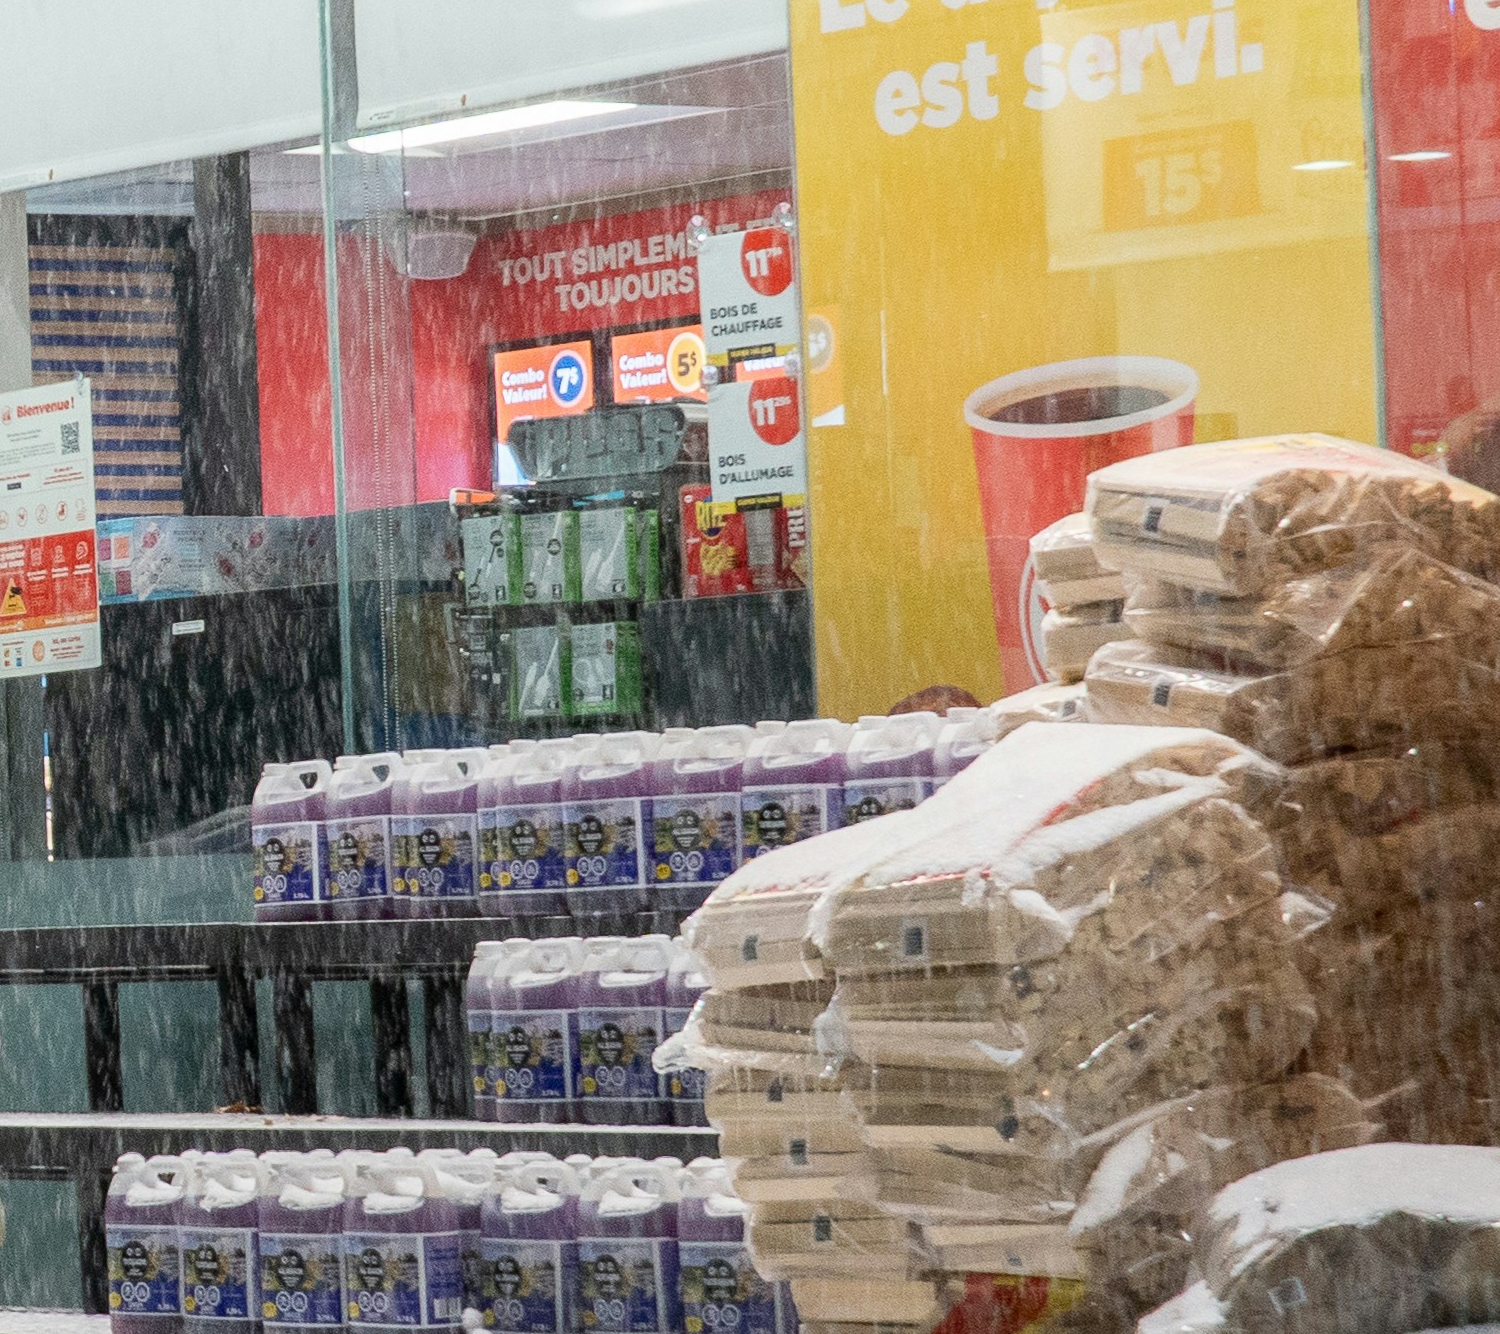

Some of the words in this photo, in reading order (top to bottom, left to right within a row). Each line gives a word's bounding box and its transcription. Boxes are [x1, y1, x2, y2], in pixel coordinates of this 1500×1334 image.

[875, 39, 999, 136] est
[500, 251, 566, 287] TOUT
[555, 267, 696, 312] TOUJOURS
[710, 305, 738, 320] BOIS
[741, 303, 758, 315] DE
[711, 317, 783, 337] CHAUFFAGE
[618, 352, 664, 370] Combo
[502, 367, 545, 387] Combo
[620, 369, 668, 390] Valeur!
[502, 385, 548, 405] Valeur!
[718, 454, 745, 468] BOIS
[719, 465, 794, 484] D'ALLUMAGE
